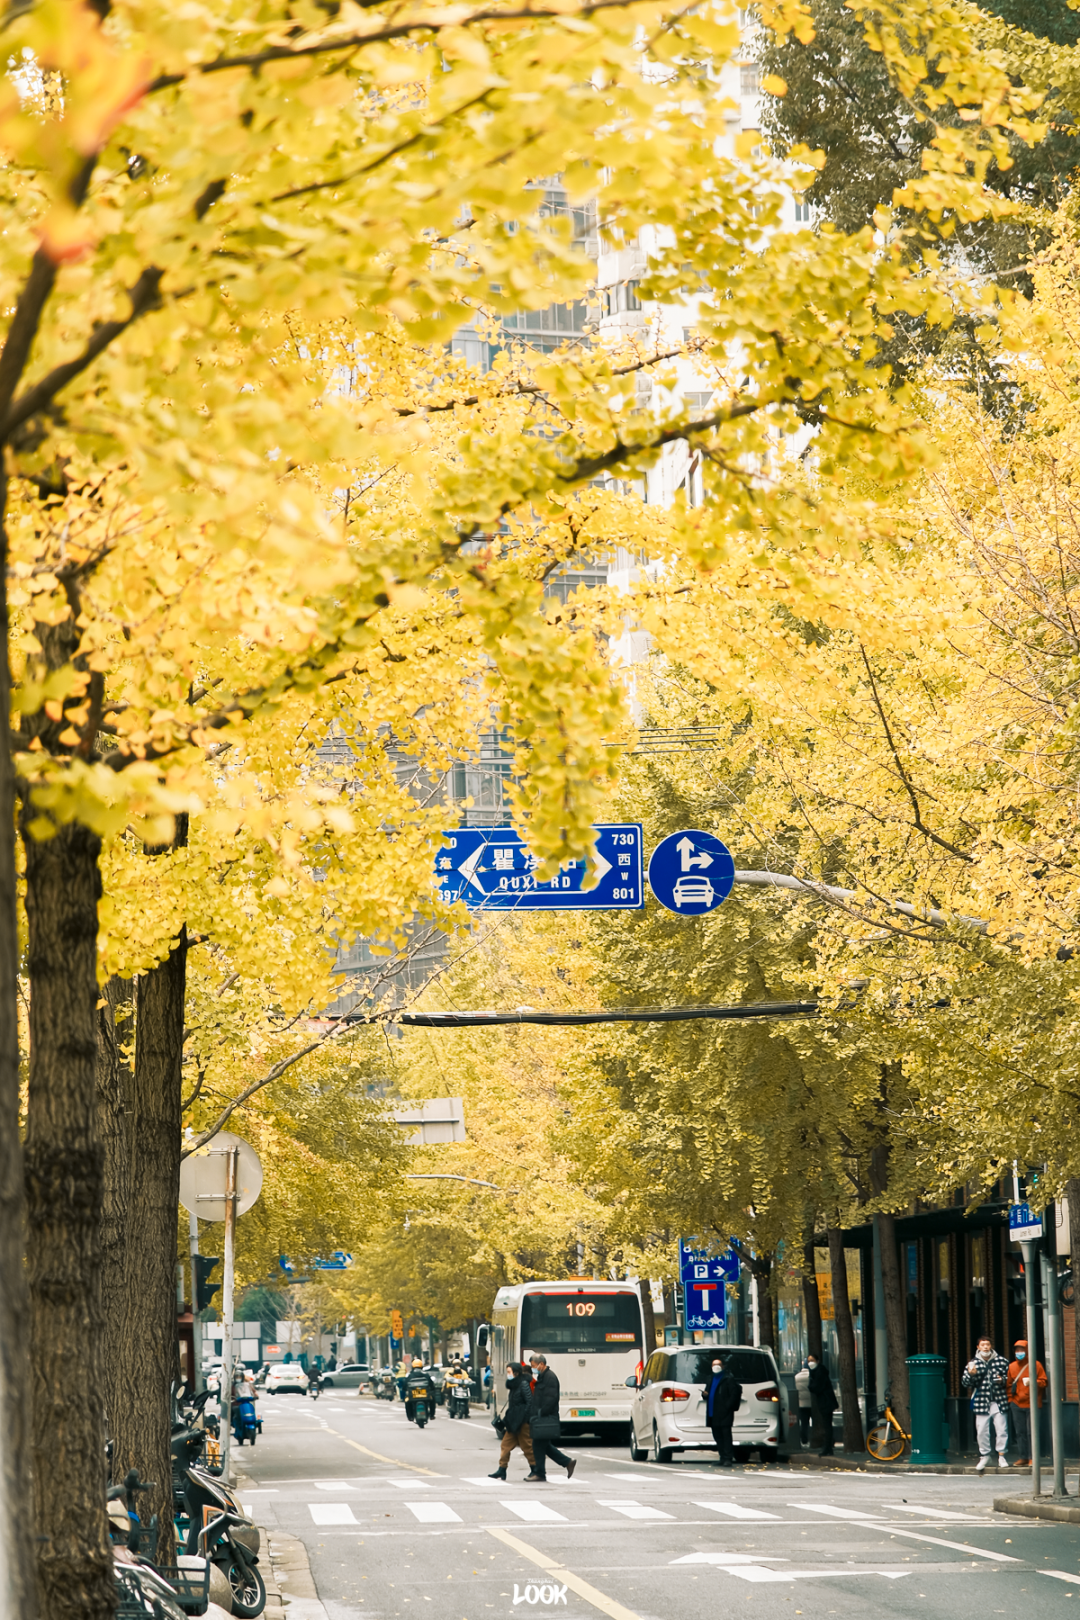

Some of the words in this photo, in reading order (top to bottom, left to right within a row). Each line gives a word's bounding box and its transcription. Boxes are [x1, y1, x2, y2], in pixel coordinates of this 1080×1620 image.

[612, 833, 635, 846] 730
[617, 852, 632, 866] 西
[550, 876, 571, 888] RD
[620, 872, 629, 881] W
[612, 887, 635, 900] 801
[565, 1302, 596, 1317] 109
